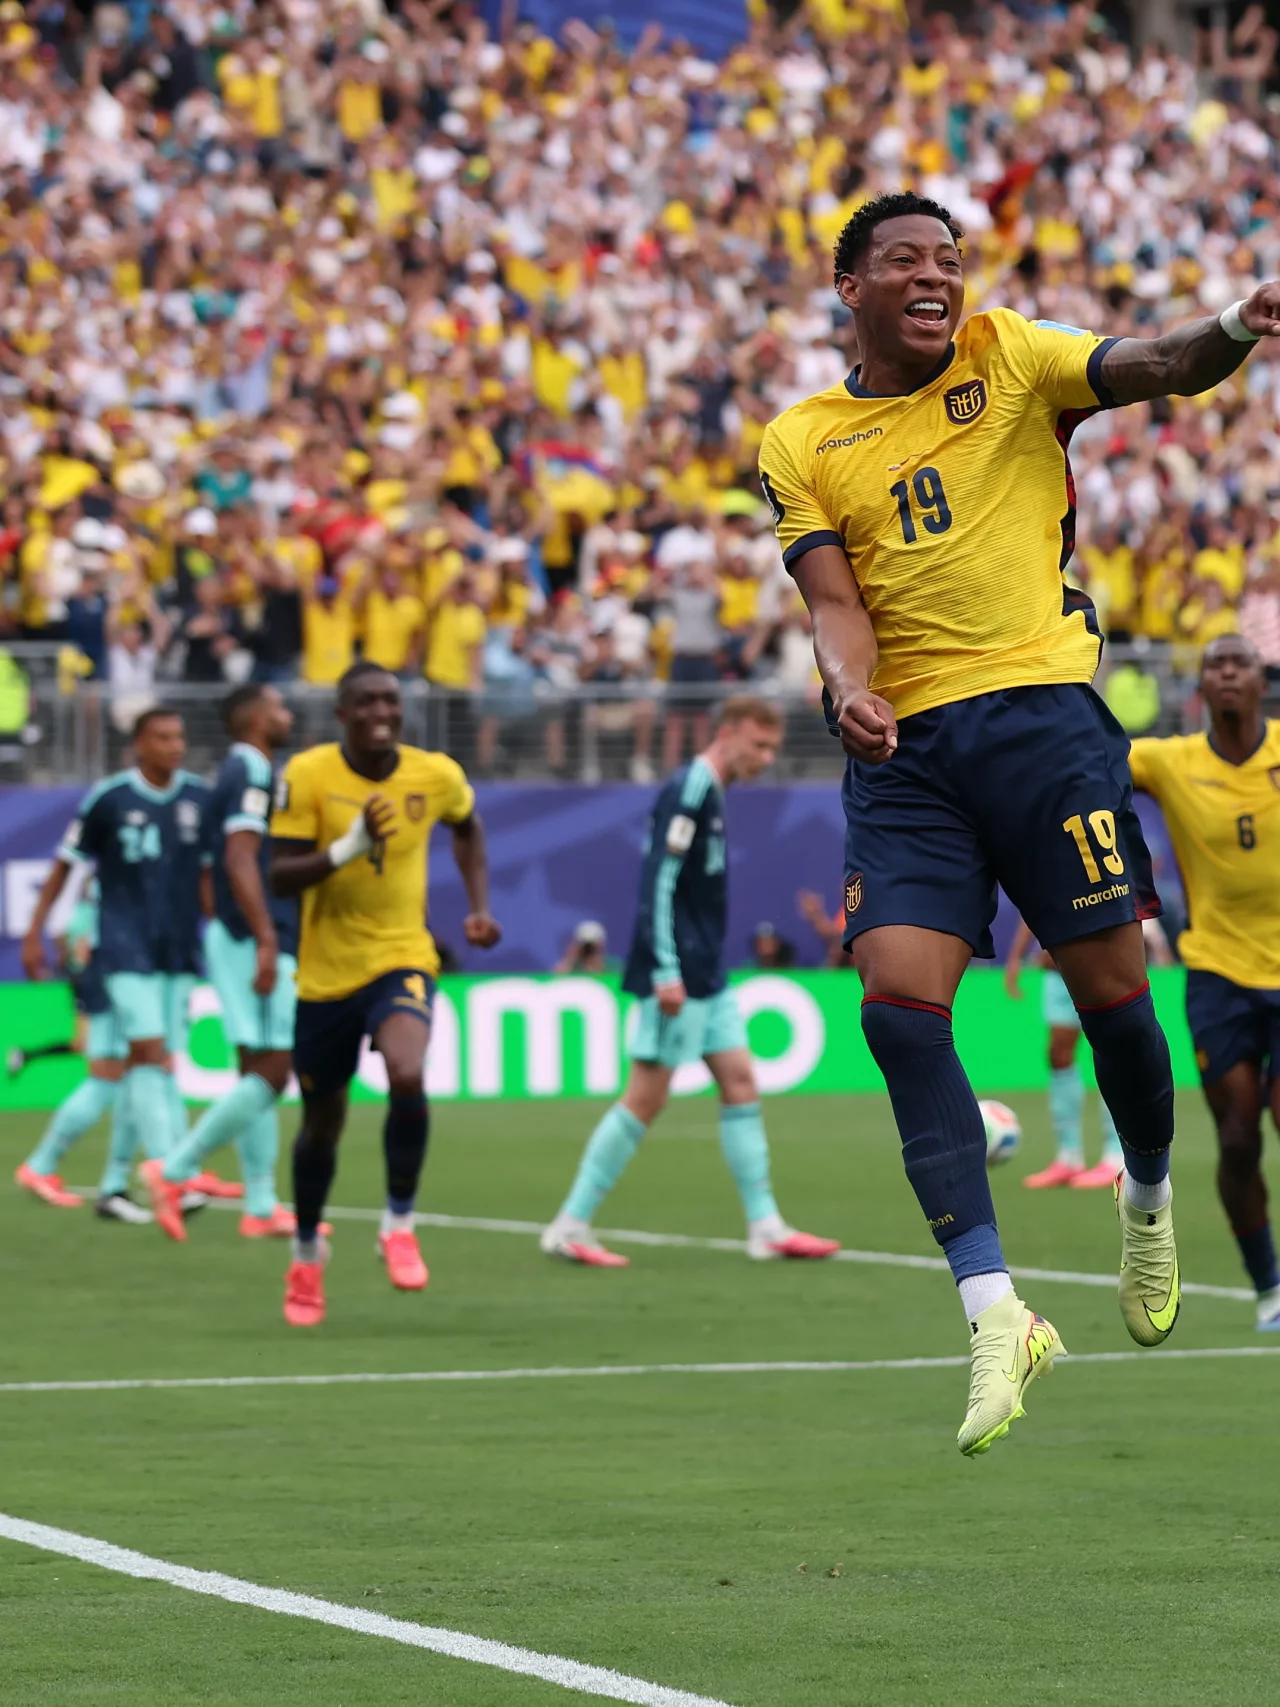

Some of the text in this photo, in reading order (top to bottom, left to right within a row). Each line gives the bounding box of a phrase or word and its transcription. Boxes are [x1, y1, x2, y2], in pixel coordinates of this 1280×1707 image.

[816, 426, 883, 456] marathon
[890, 466, 953, 545] 19
[1063, 809, 1124, 884] 19
[1237, 814, 1256, 851] 6
